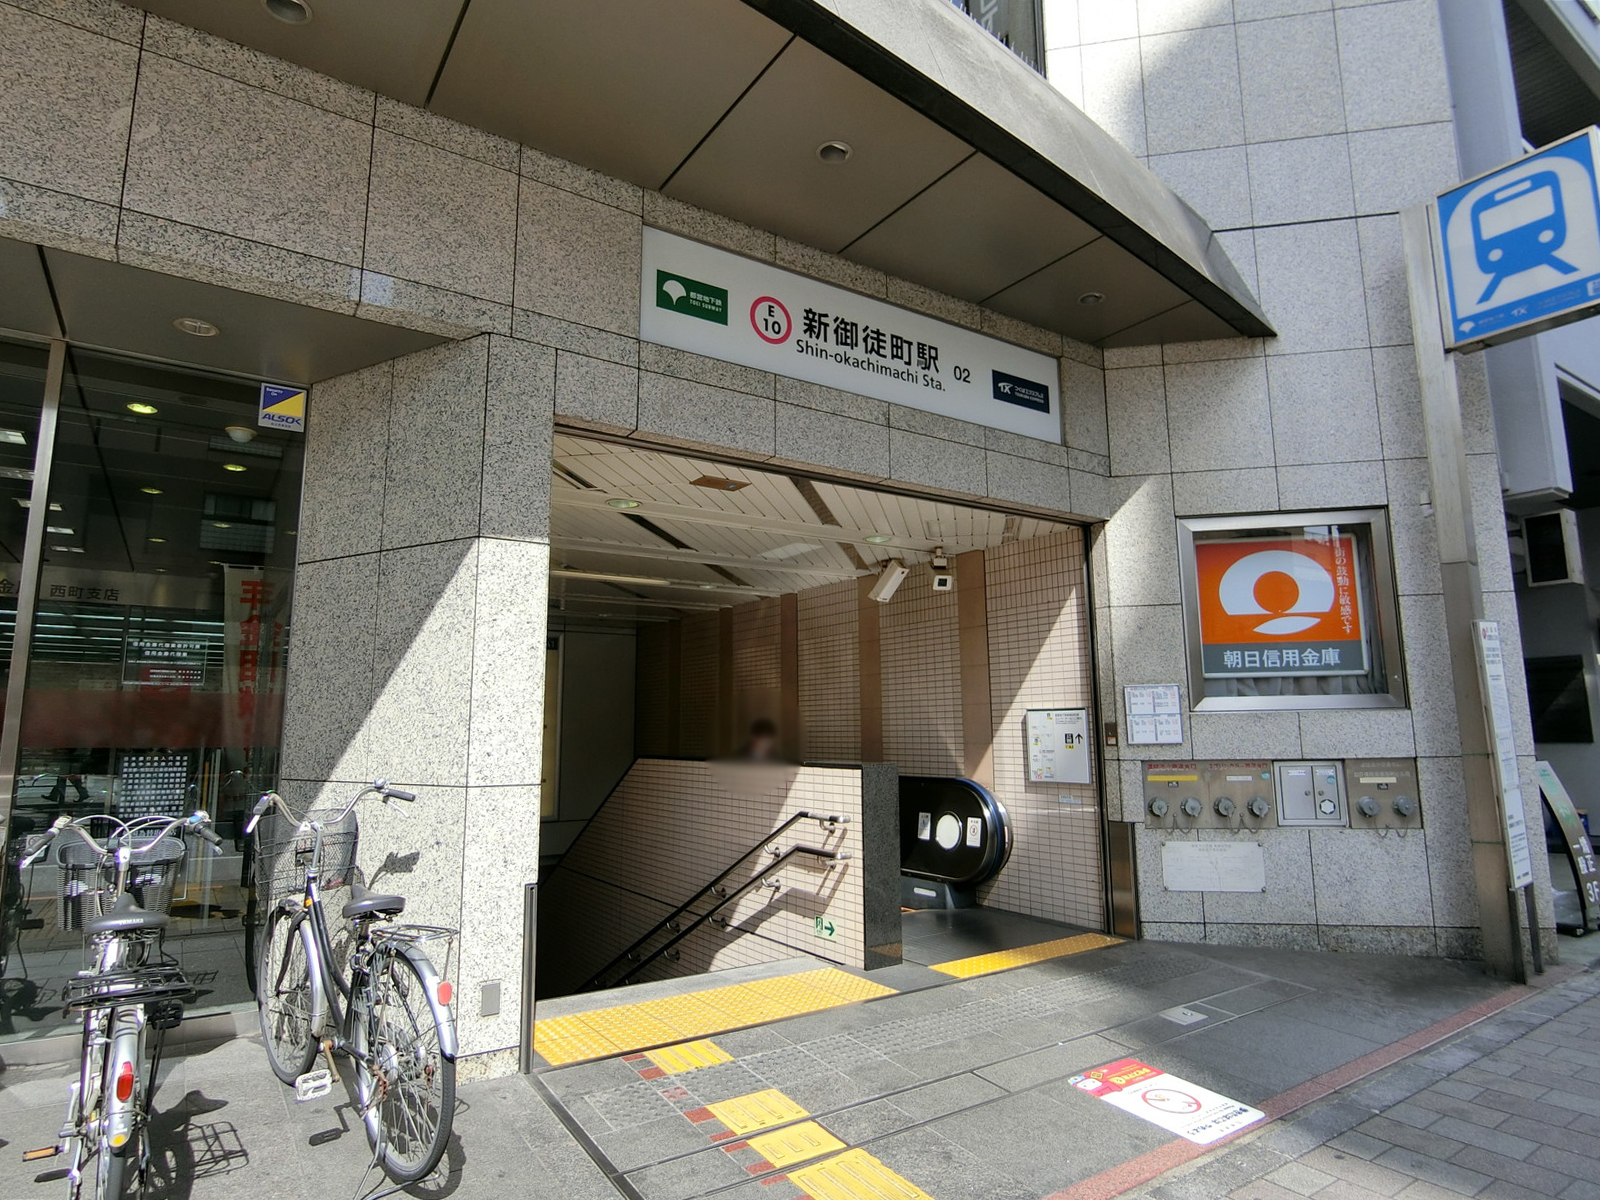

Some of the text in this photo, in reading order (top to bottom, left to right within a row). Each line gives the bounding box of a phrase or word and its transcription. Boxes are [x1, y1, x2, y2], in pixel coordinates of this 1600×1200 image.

[690, 291, 723, 307] 都営地下鉄
[701, 303, 722, 312] SUBWAY
[768, 304, 775, 318] E
[763, 317, 782, 335] 10
[803, 308, 940, 374] 新御徒町駅
[796, 339, 946, 392] Shin-okachimachi Sta.
[953, 365, 972, 384] 02
[262, 413, 302, 425] ALSOK
[0, 578, 120, 601] 金 西町支店
[1223, 647, 1341, 669] 朝日信用金庫
